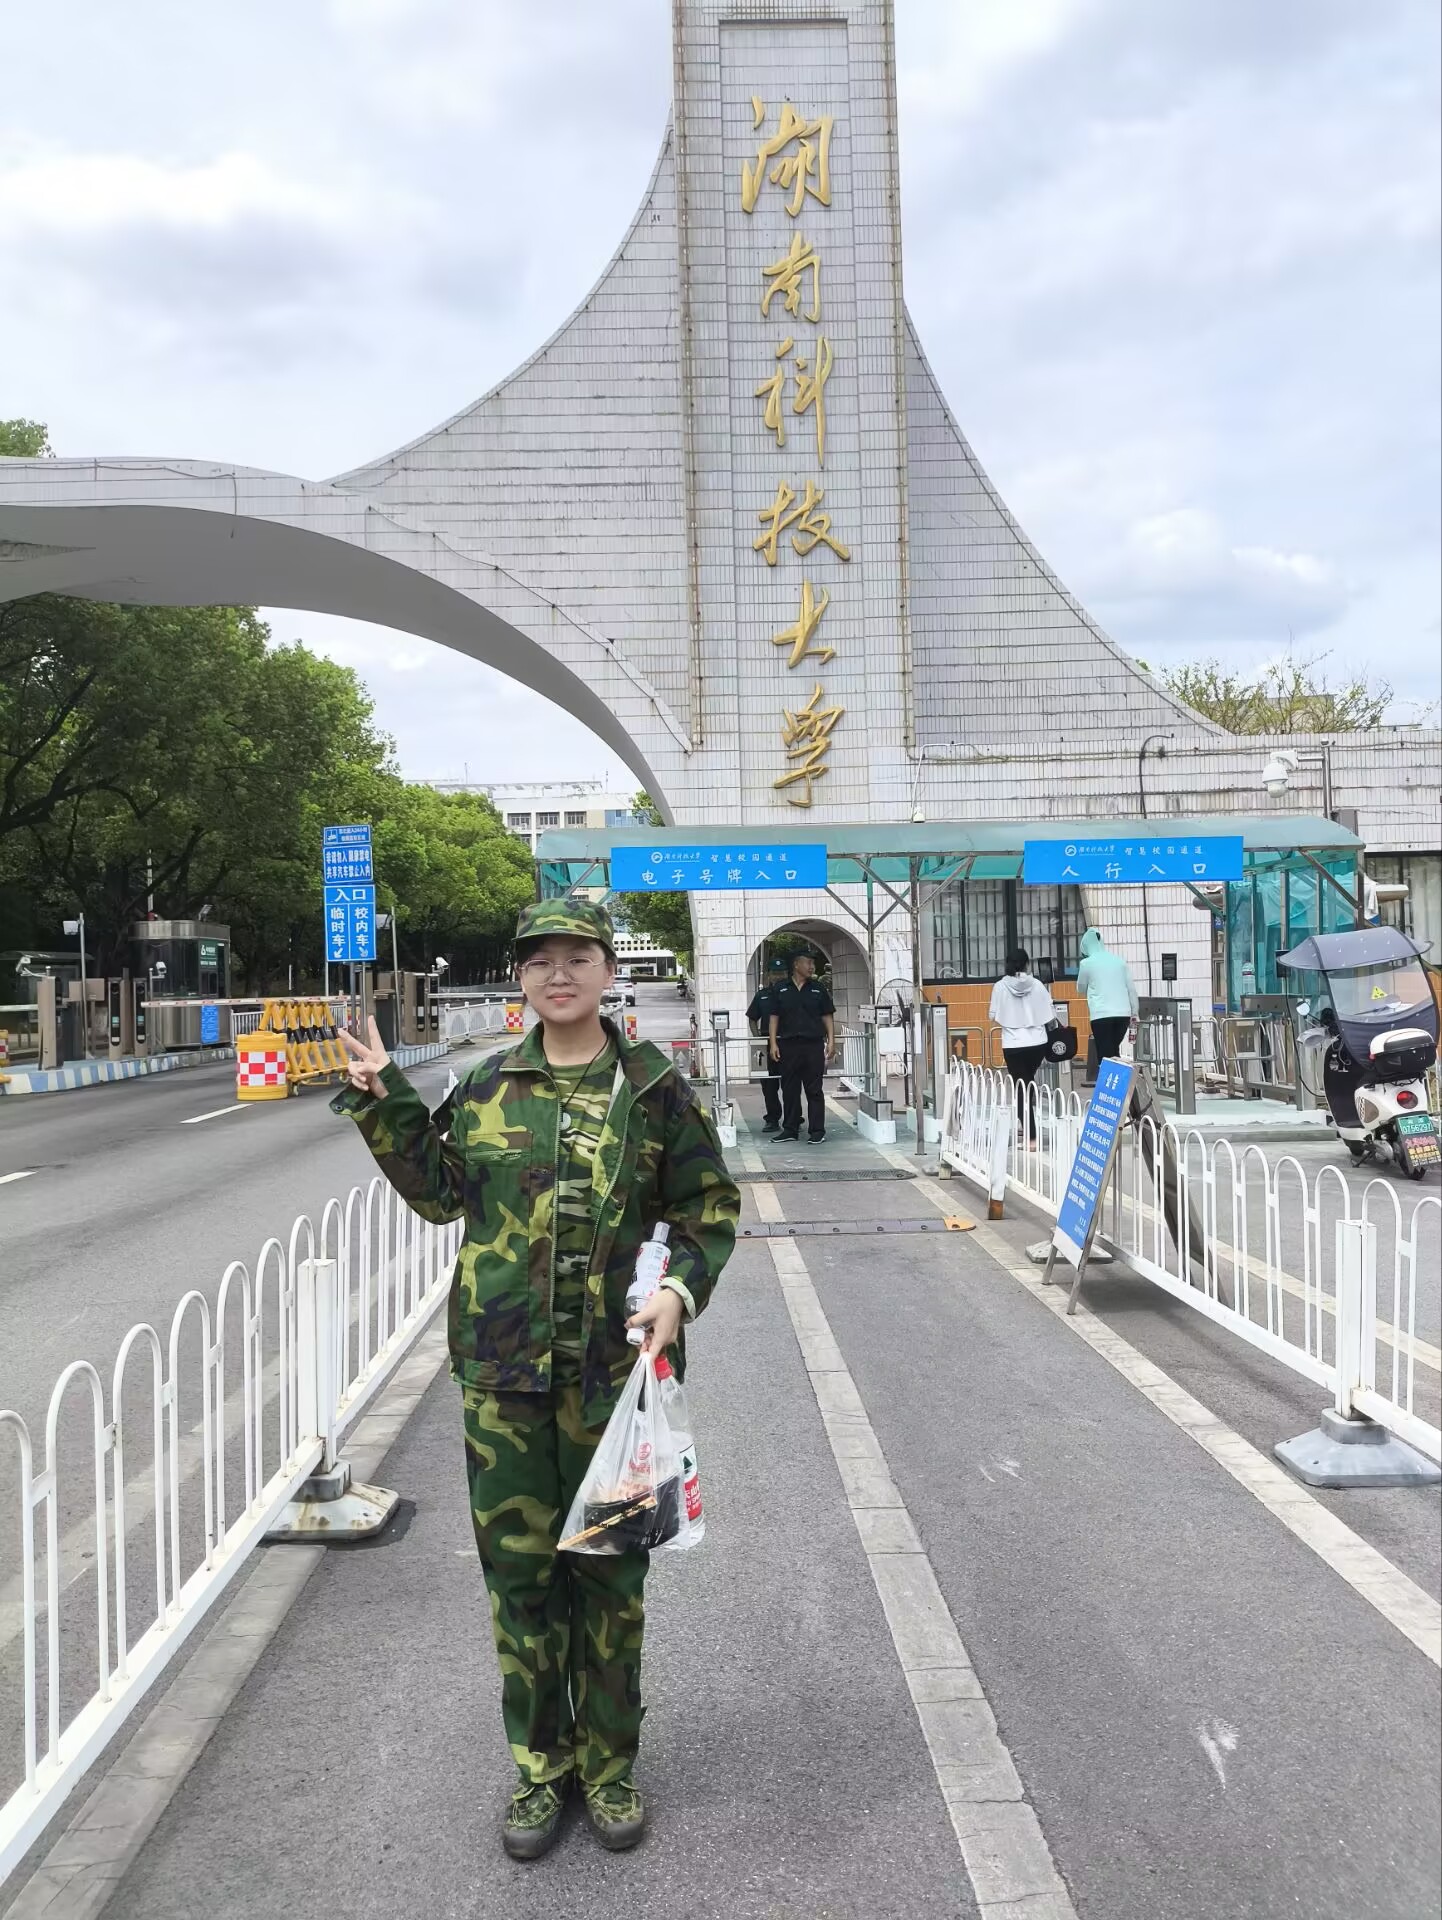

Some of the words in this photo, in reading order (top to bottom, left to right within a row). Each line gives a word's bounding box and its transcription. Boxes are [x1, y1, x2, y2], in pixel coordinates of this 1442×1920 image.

[710, 853, 789, 863] 智慧校园通道
[1124, 845, 1204, 855] 智慧校园通道
[641, 868, 798, 885] 电子号牌入口
[1061, 862, 1207, 879] 人行入口
[334, 888, 367, 902] 入口
[330, 907, 346, 947] 临时车
[354, 906, 369, 947] 校内车
